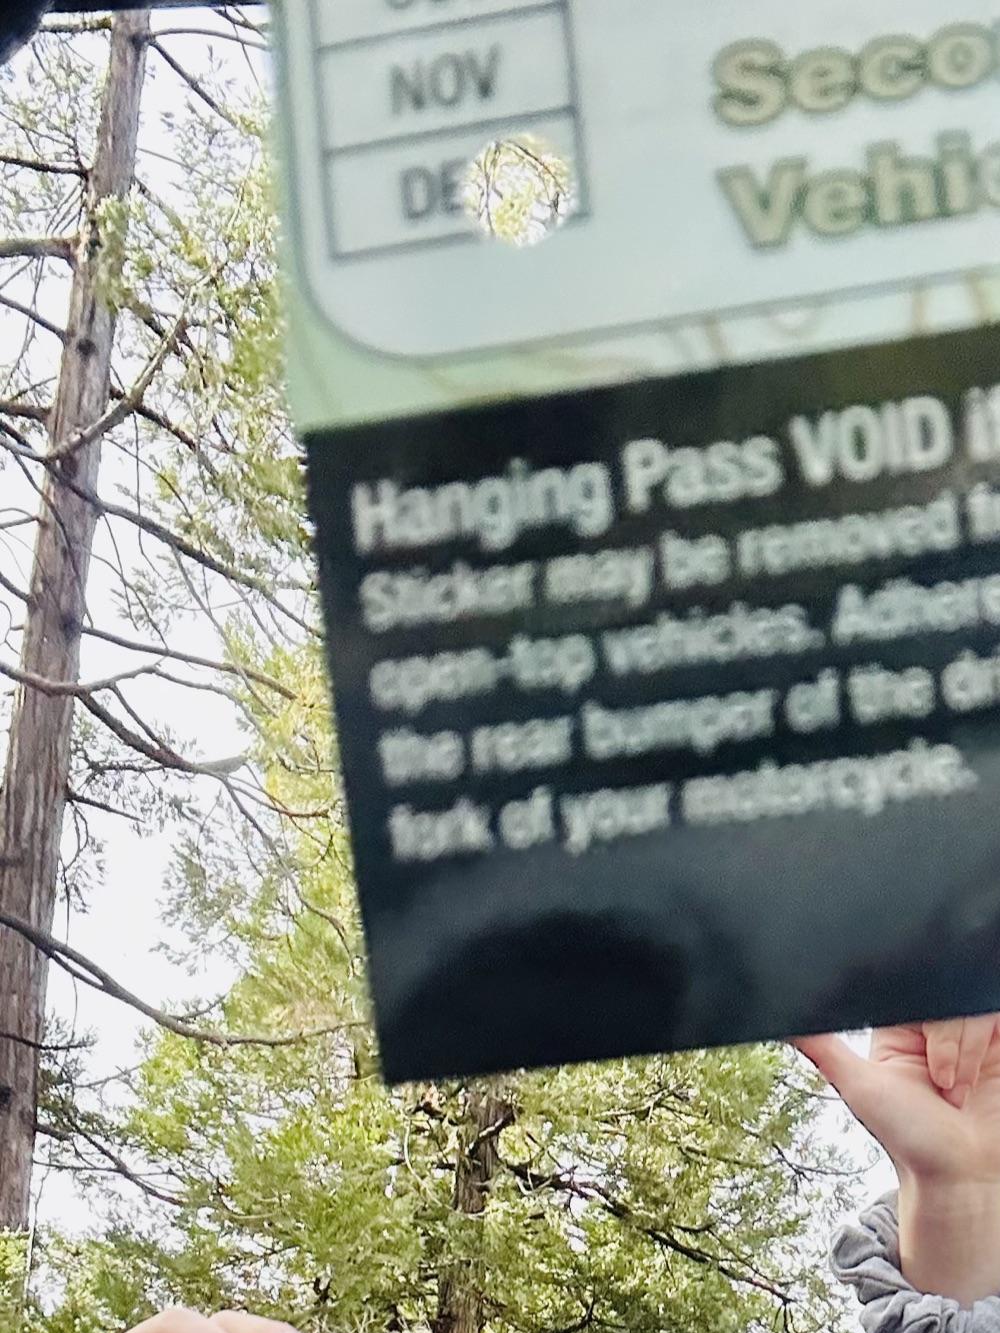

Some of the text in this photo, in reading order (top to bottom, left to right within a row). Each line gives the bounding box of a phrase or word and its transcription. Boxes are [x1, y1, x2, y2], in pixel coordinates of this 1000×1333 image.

[389, 41, 501, 117] NOV
[400, 158, 472, 221] DE
[351, 458, 614, 556] Hanging
[620, 436, 784, 513] Pass
[789, 395, 954, 486] VOID
[358, 560, 536, 635] Sticker
[543, 544, 654, 610] may
[659, 527, 732, 590] be
[736, 490, 960, 580] removed
[369, 631, 598, 716] open-top
[602, 599, 826, 677] vehicles.
[377, 724, 465, 787] the
[470, 713, 575, 775] rear
[580, 687, 779, 761] bumper
[783, 664, 841, 733] of
[846, 661, 936, 725] the
[387, 797, 496, 864] fork
[498, 783, 556, 852] of
[559, 780, 674, 858] your
